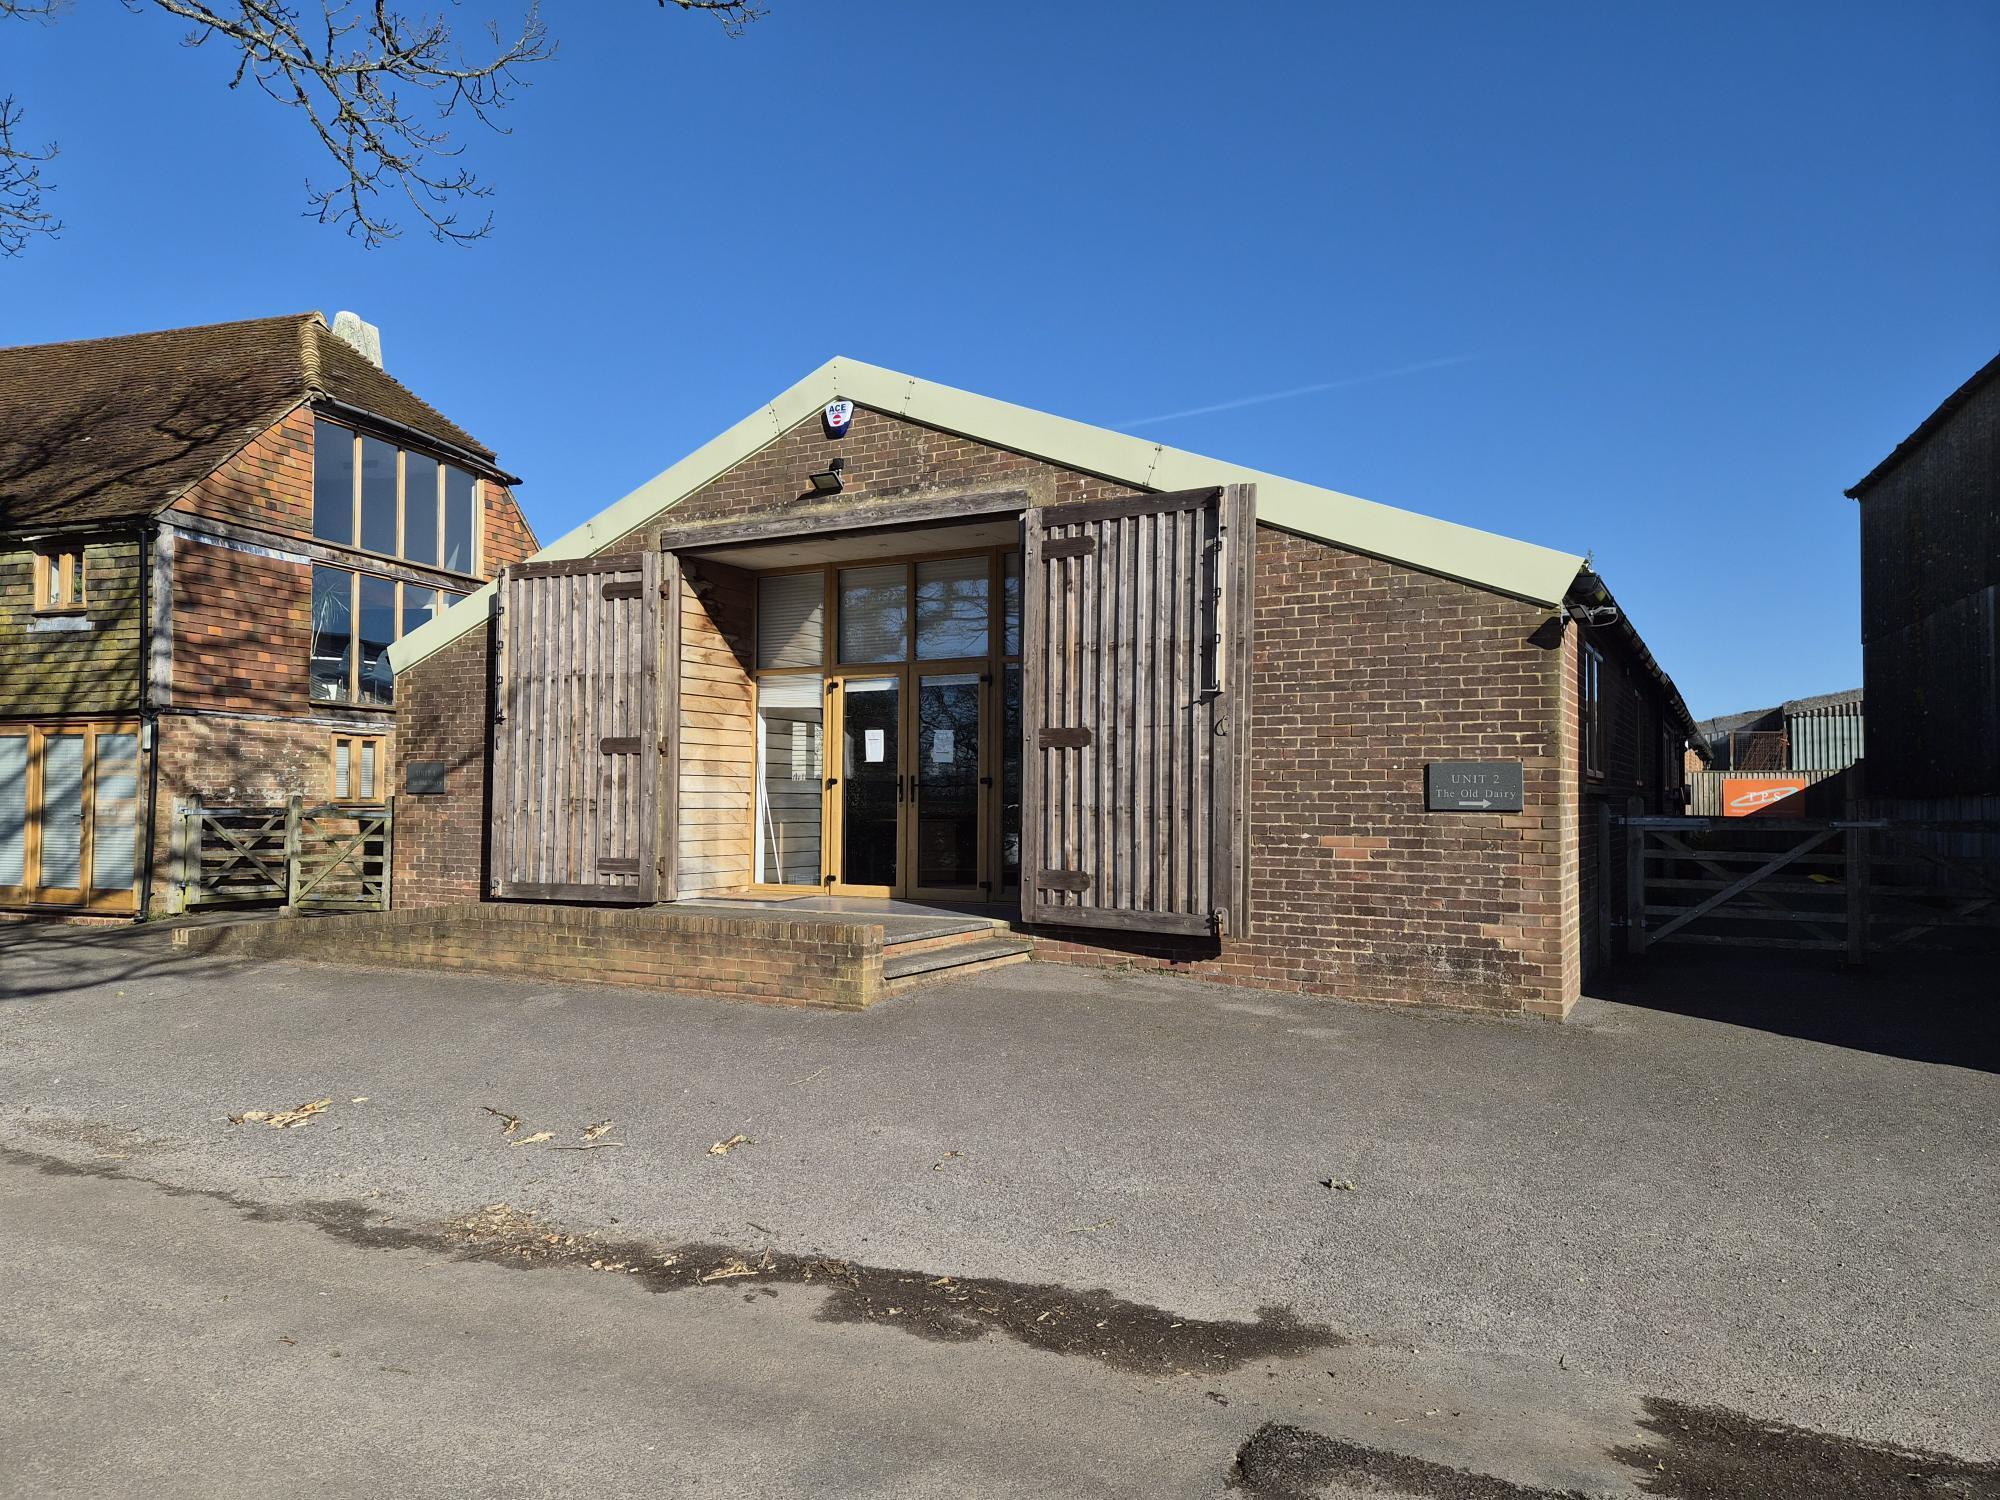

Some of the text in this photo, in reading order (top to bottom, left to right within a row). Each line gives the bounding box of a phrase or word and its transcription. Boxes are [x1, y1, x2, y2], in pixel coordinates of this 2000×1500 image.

[829, 404, 846, 413] ACE
[1451, 774, 1500, 784] UNIT 2
[1435, 788, 1516, 800] The Old Dairy
